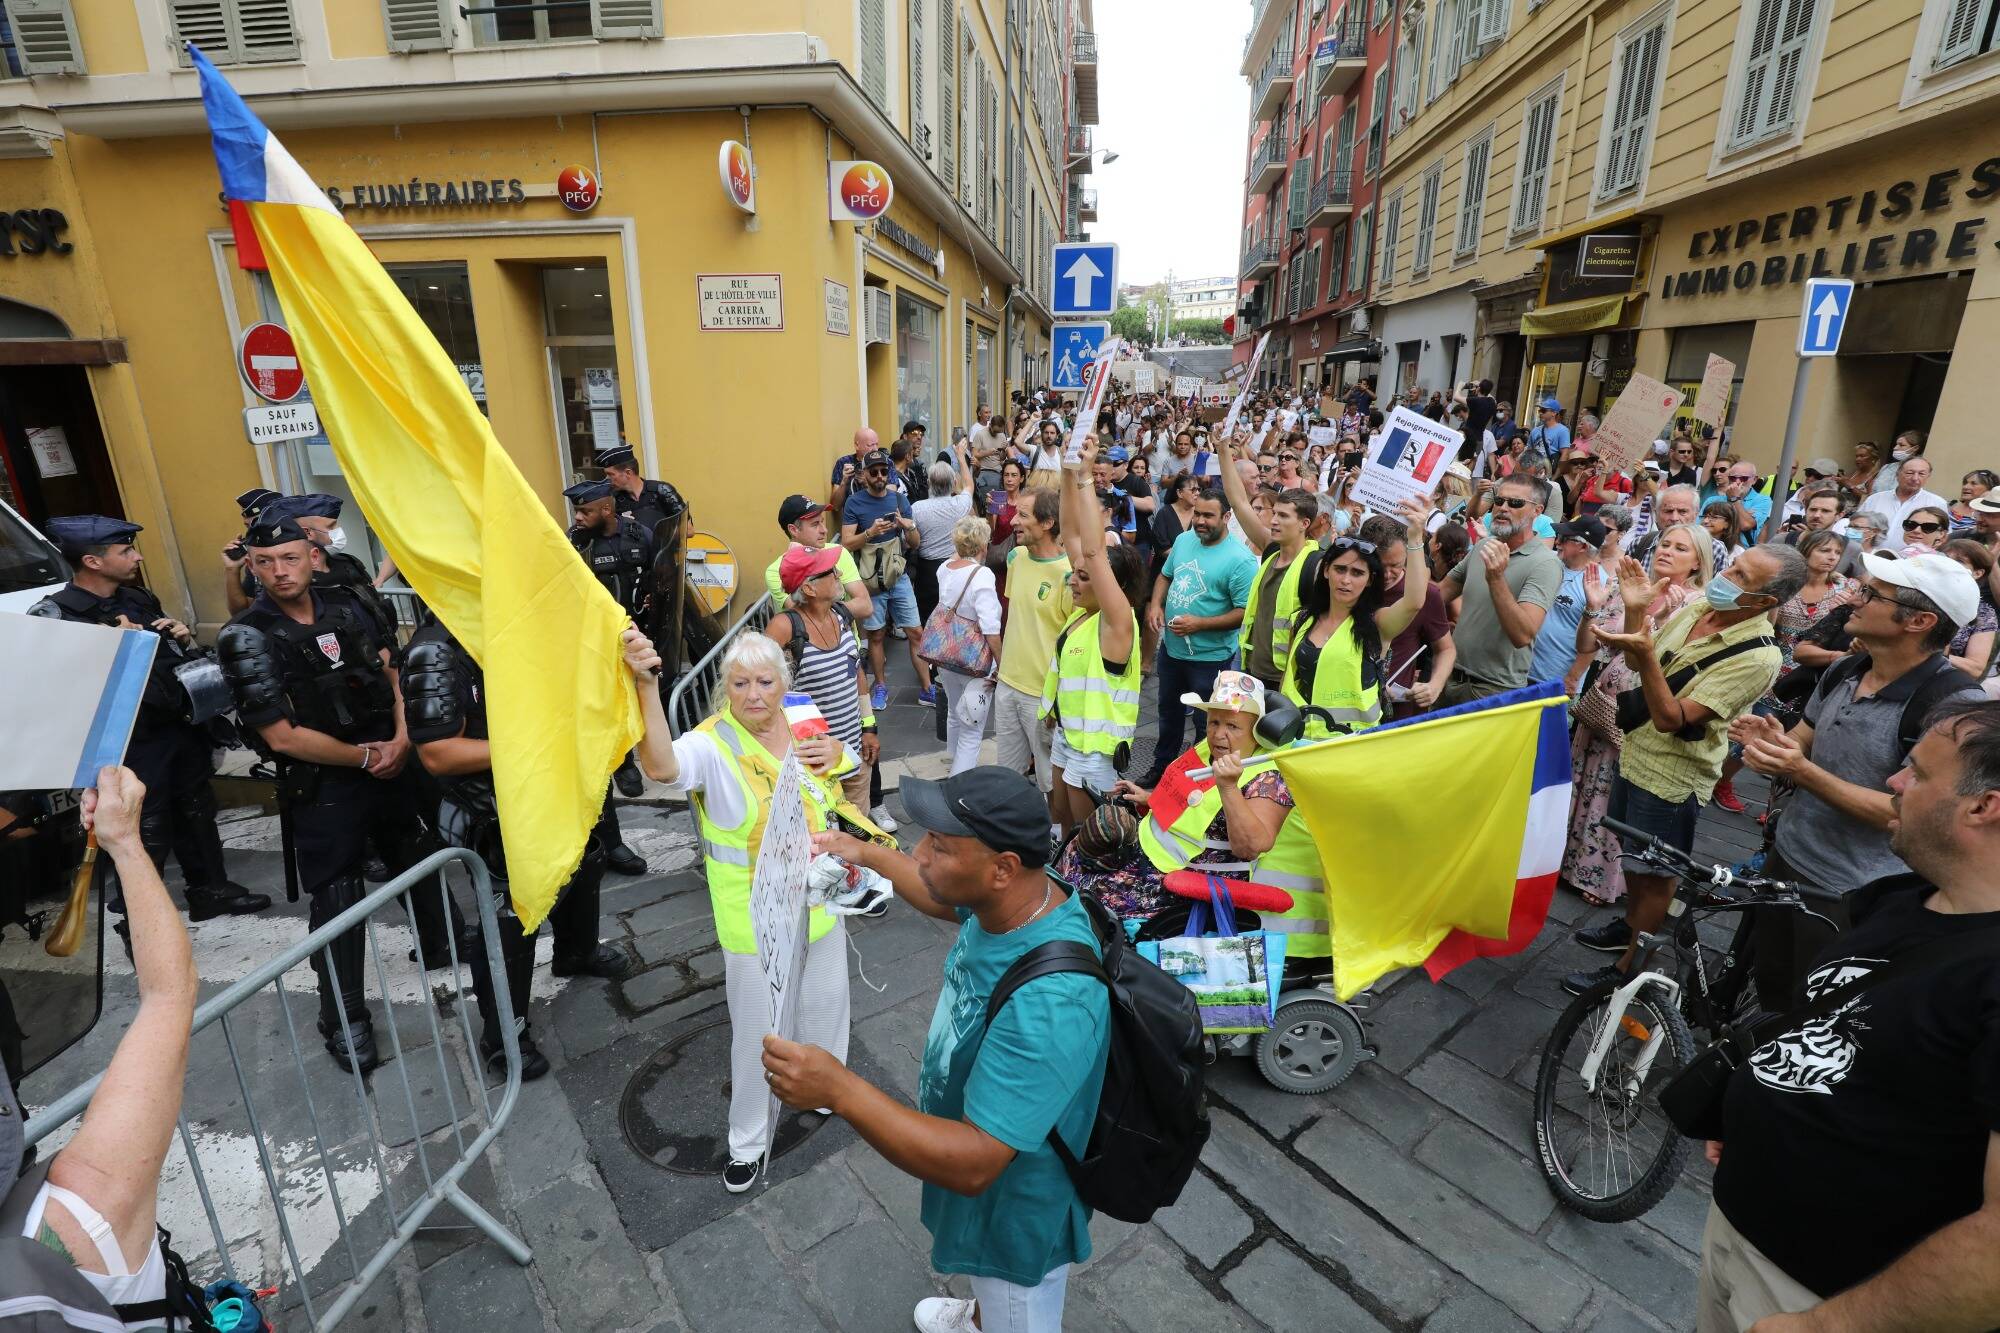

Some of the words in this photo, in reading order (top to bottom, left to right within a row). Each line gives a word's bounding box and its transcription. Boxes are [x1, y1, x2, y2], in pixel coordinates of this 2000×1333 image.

[734, 177, 748, 195] PFG
[353, 177, 525, 208] FUNÉRAIRES
[566, 191, 592, 203] PFG
[850, 195, 880, 207] PFG
[1687, 157, 2000, 259] EXPERTISES
[1593, 246, 1631, 255] Cigarettes
[1585, 257, 1635, 267] électroniques
[1661, 217, 2000, 299] IMMOBILIERE
[731, 279, 748, 288] RUE
[704, 291, 713, 299] DE
[718, 306, 765, 314] CARRIERA
[712, 317, 724, 325] DE
[728, 316, 771, 325] L'ESPITAU
[268, 409, 297, 420] SAUF
[254, 421, 315, 437] RIVERAINS
[1395, 416, 1452, 443] Rejoignez-nous
[1591, 1010, 1611, 1055] MERIDA
[1535, 1120, 1557, 1177] MERIDA
